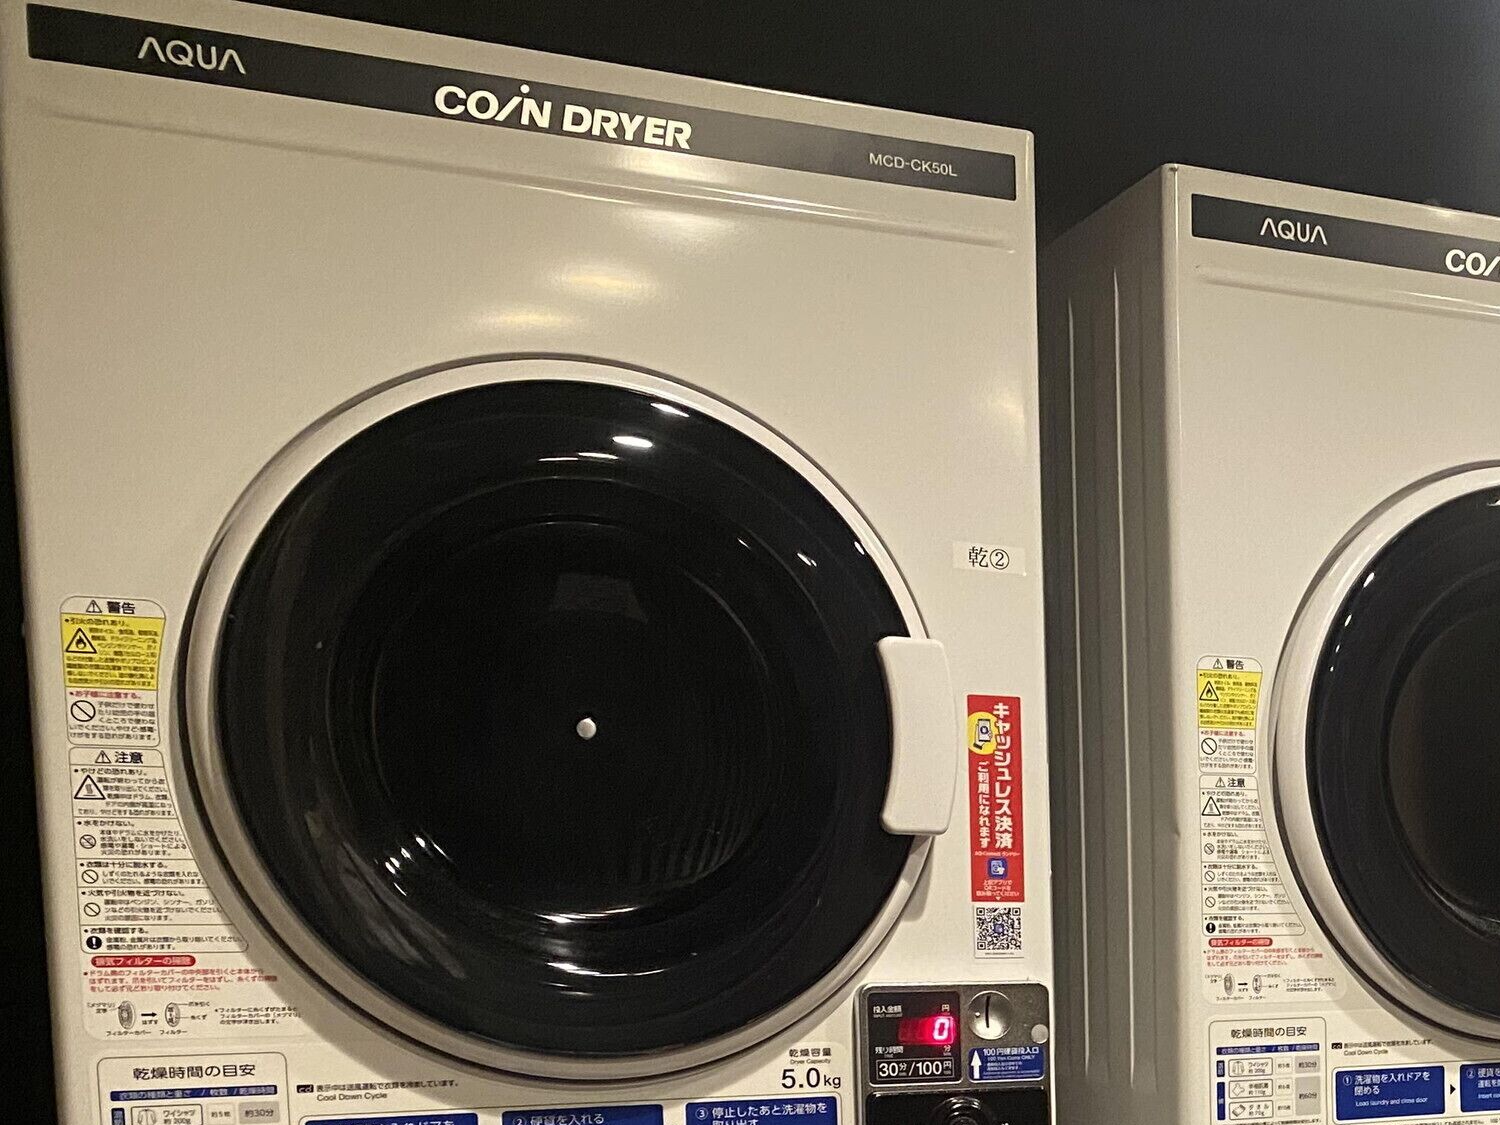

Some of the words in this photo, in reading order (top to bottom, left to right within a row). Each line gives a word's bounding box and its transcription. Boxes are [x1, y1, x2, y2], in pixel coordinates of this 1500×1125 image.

[138, 36, 246, 76] AQUA
[434, 83, 550, 130] COIN
[562, 107, 692, 151] DRYER
[868, 152, 959, 178] MCD-CK50L
[1260, 217, 1327, 246] AQUA
[968, 548, 1010, 570] 乾②
[106, 600, 136, 614] 警告
[114, 751, 144, 764] 注意
[993, 703, 1013, 849] キャッシュレス決済
[1227, 777, 1245, 788] 注意
[977, 761, 990, 848] ご利用になれます
[933, 1017, 950, 1041] 0
[1230, 1026, 1307, 1039] 乾燥時間の目安
[132, 1063, 257, 1081] 乾燥時間の目安
[781, 1067, 821, 1089] 5.0
[824, 1074, 842, 1089] kg
[1354, 1071, 1431, 1085] 洗濯物を入れドアを
[316, 1093, 337, 1102] Cool
[364, 1092, 388, 1100] Cycle
[244, 1108, 275, 1118] 約30分
[695, 1107, 709, 1120] ③
[712, 1102, 828, 1119] 停止したあと洗濯物を
